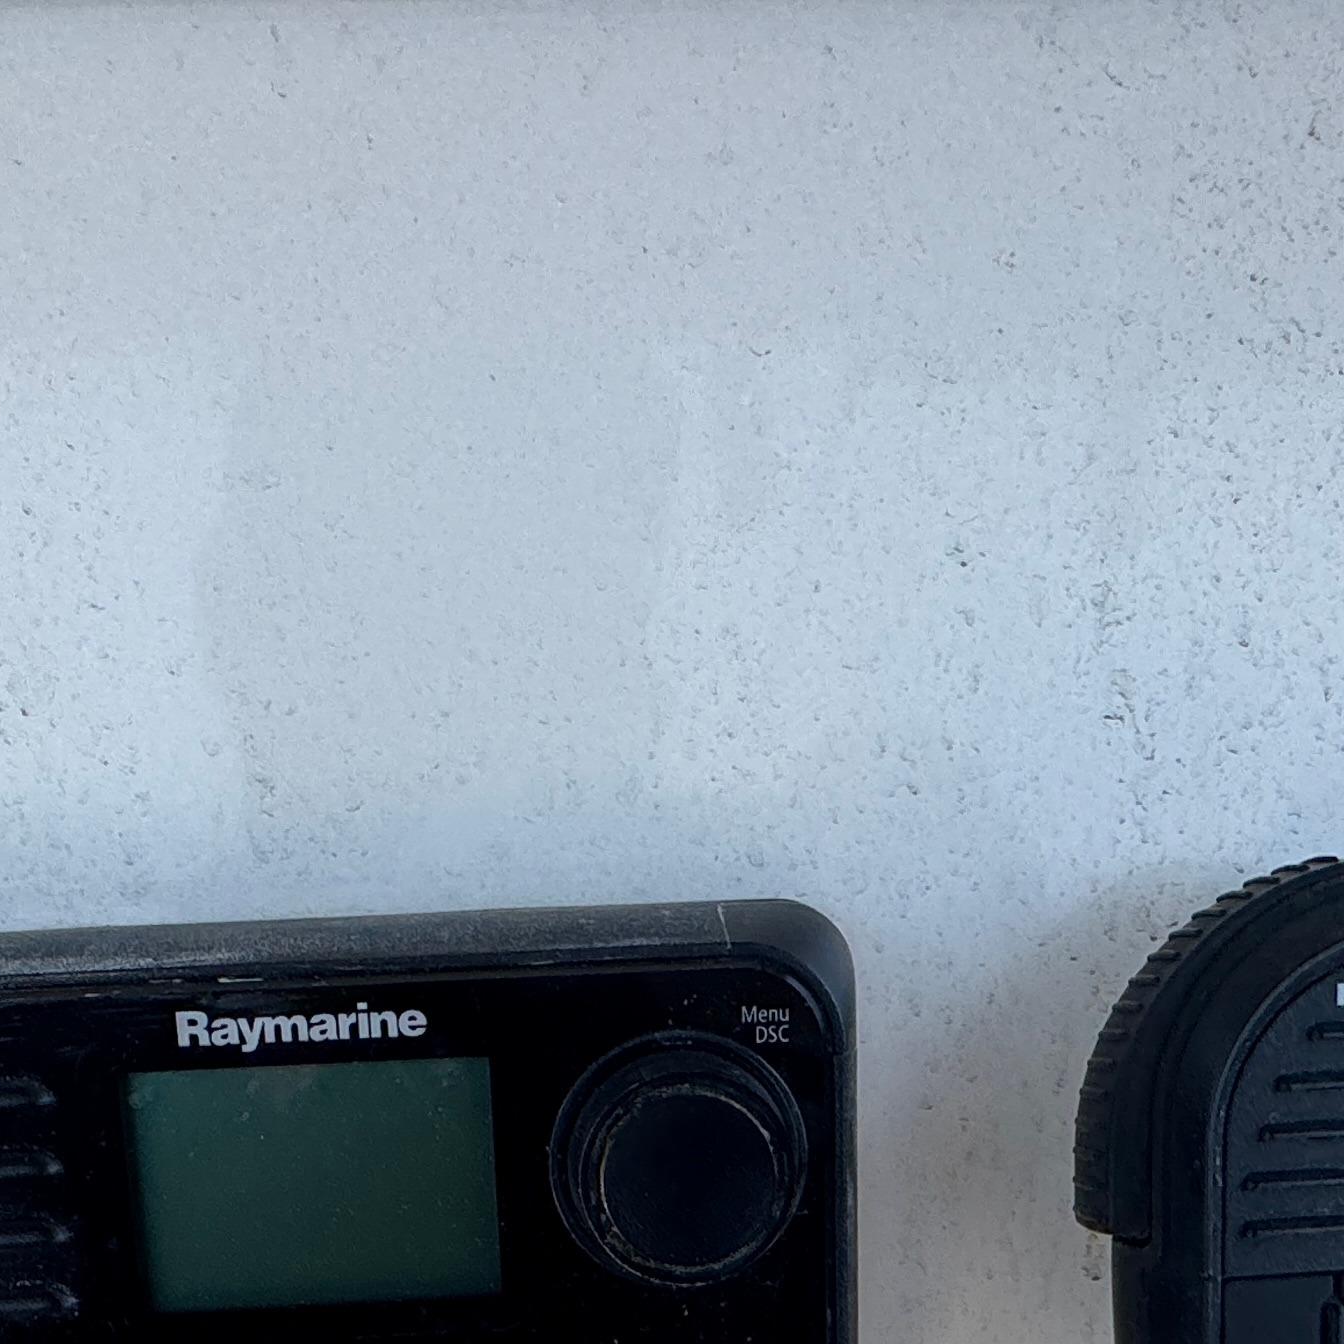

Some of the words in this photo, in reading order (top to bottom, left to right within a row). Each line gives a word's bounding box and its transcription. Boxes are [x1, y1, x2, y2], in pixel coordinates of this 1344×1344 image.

[740, 1004, 790, 1024] Menu
[175, 1002, 428, 1053] Raymarine
[755, 1024, 790, 1044] DSC
